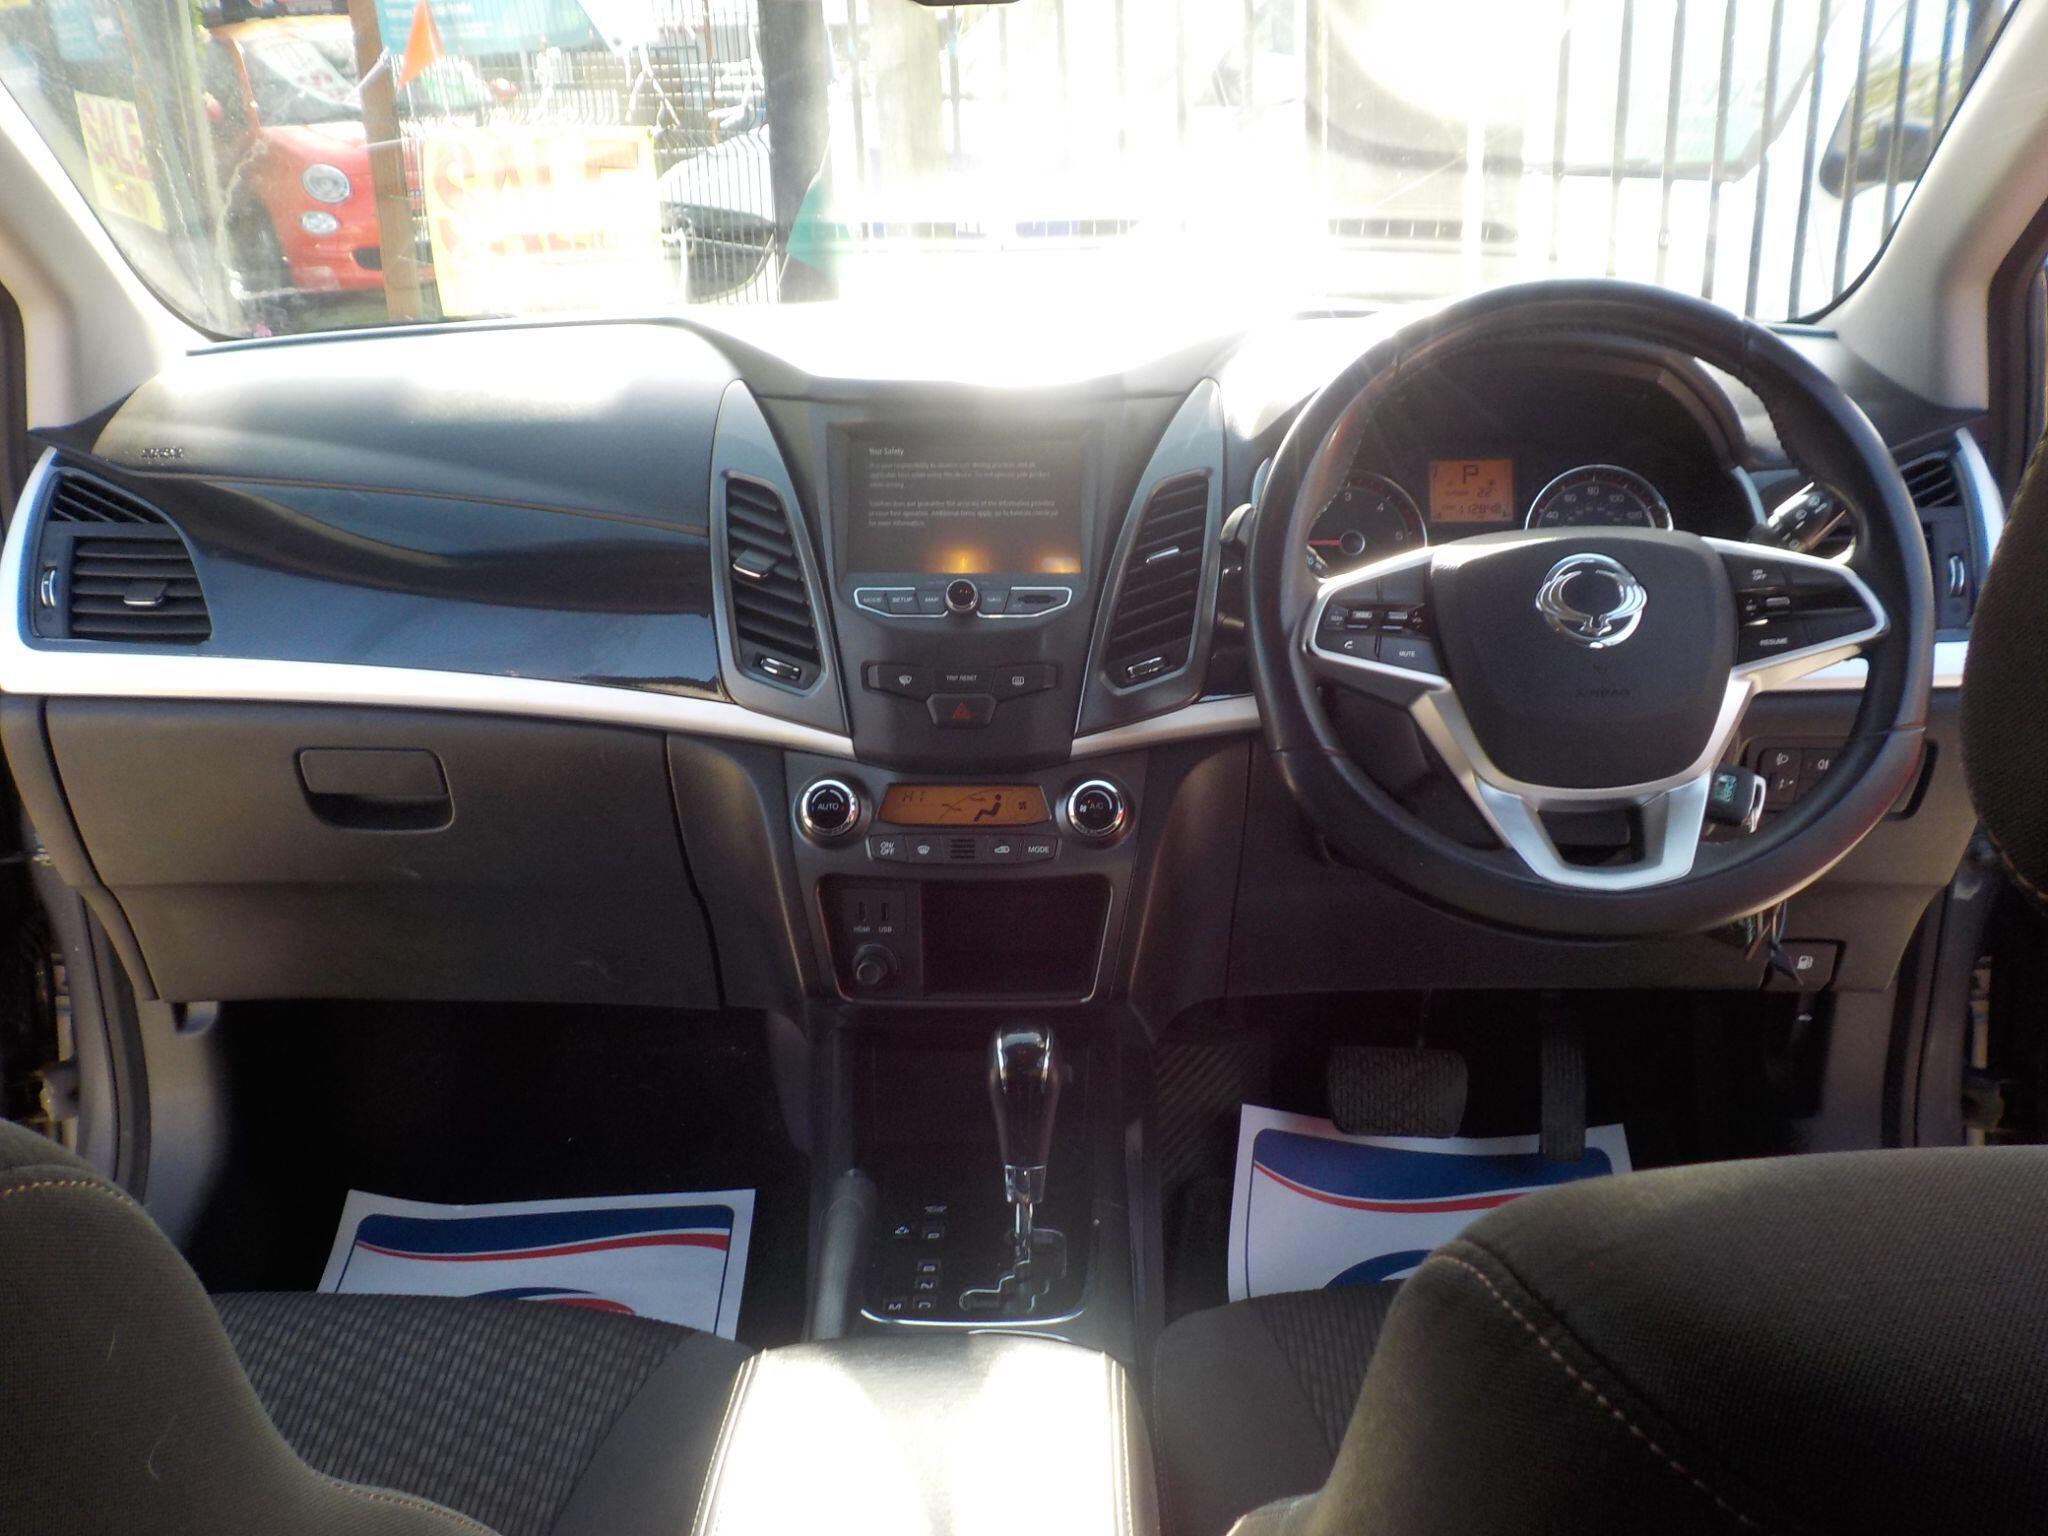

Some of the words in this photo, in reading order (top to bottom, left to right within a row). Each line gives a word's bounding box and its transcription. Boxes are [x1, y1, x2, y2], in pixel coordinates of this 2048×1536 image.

[884, 446, 905, 457] Safety
[1462, 464, 1479, 485] P
[1545, 510, 1559, 520] 40
[817, 802, 839, 811] AUTO
[880, 848, 896, 856] OFF
